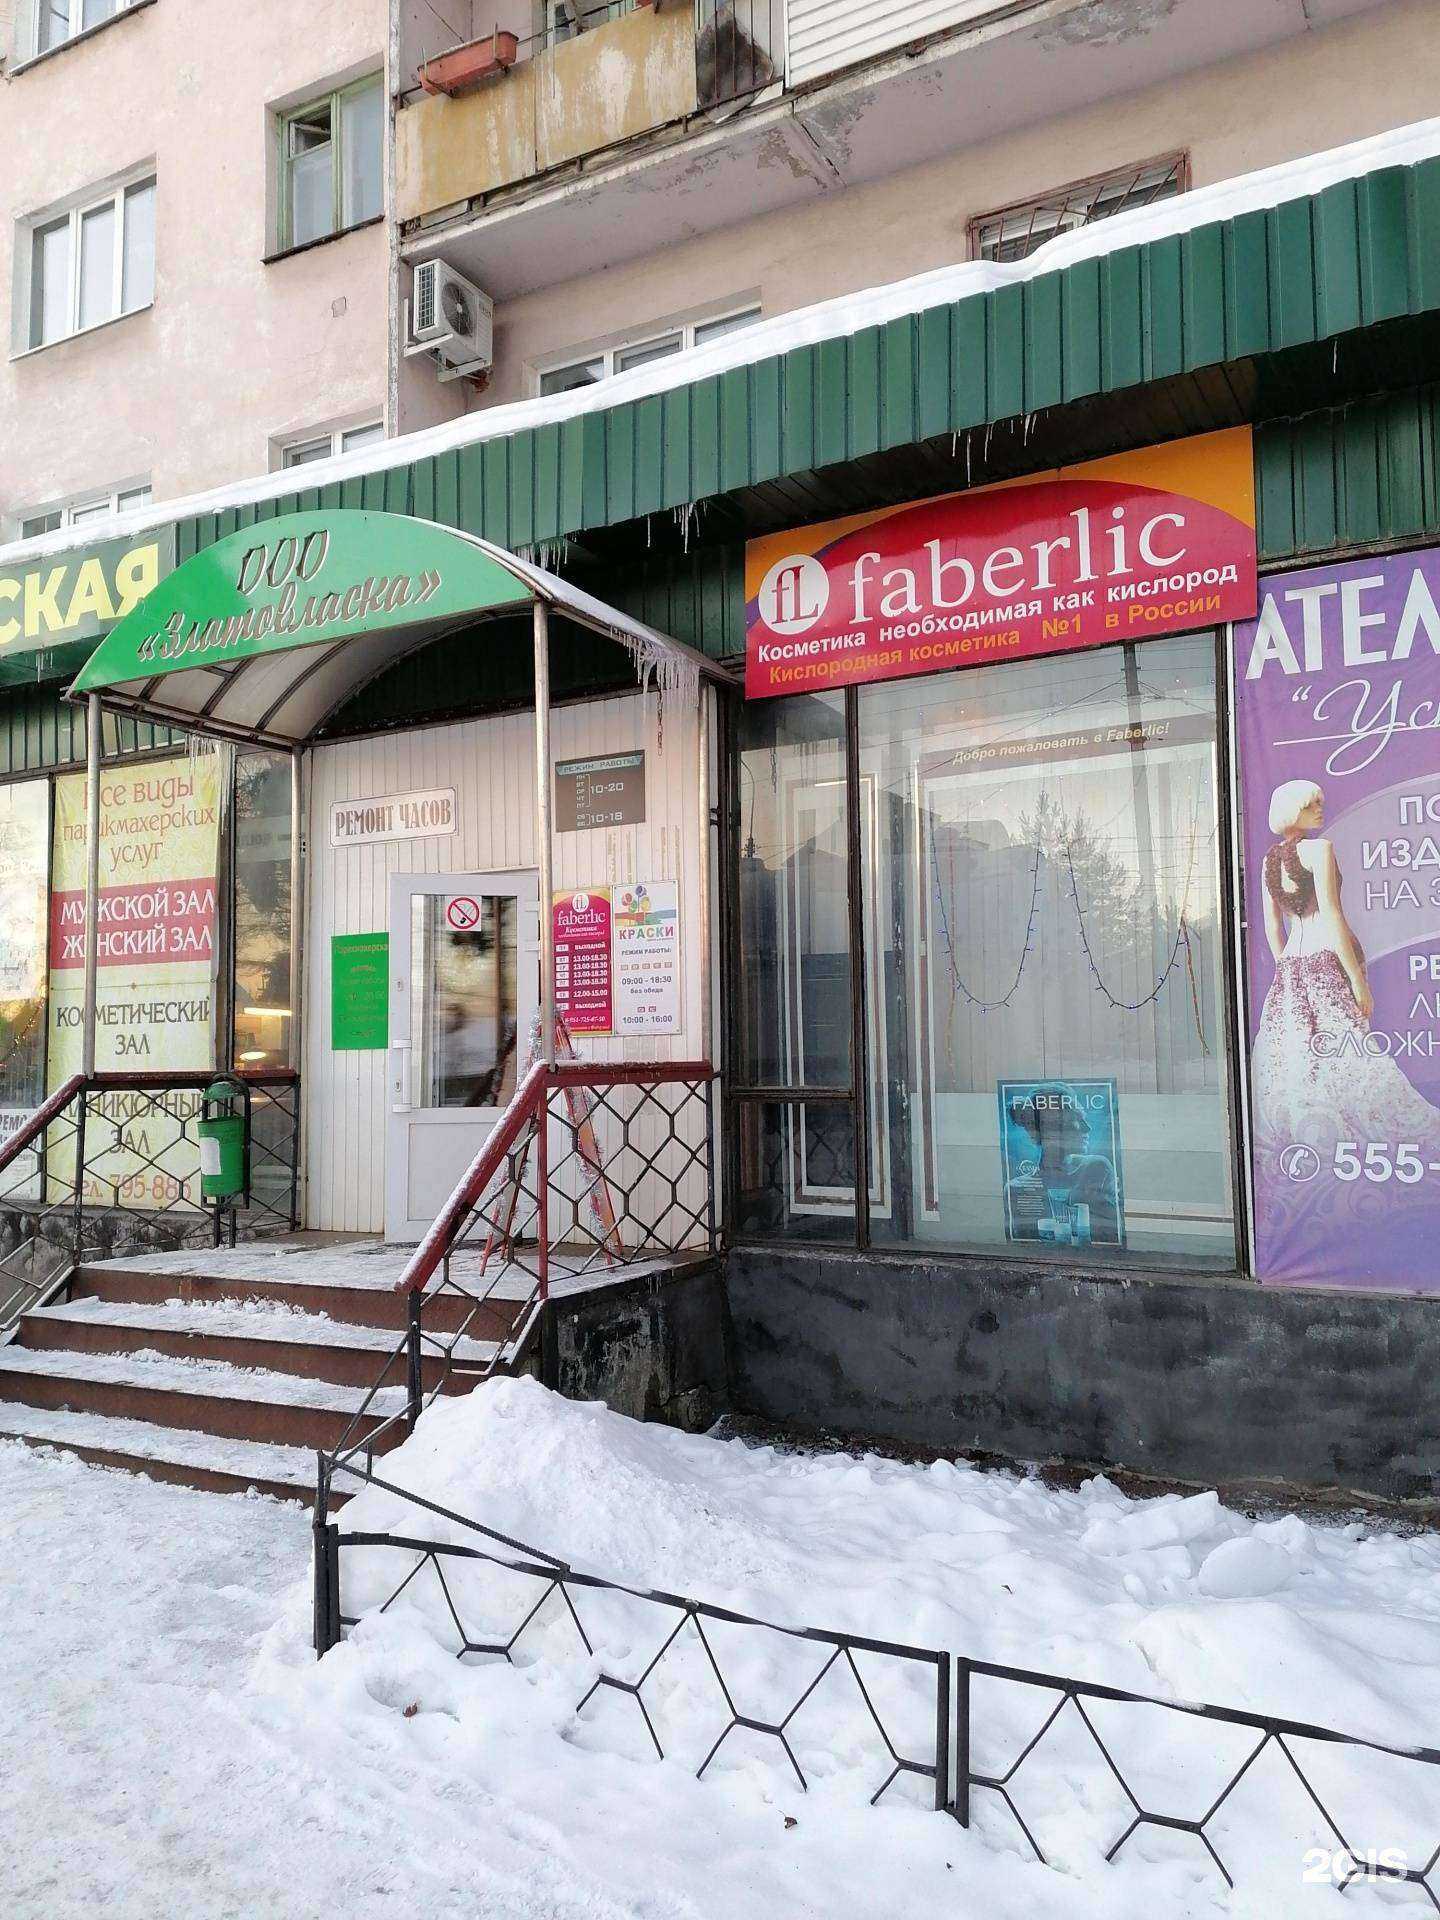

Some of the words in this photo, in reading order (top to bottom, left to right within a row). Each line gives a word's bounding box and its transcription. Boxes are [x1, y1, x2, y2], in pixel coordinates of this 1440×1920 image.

[237, 529, 330, 596] ООО
[849, 507, 1186, 625] faberlic
[136, 569, 442, 663] «Златовласка»
[758, 632, 866, 663] Косметика
[879, 600, 1043, 643] необходимая
[1053, 589, 1096, 612] как
[1107, 564, 1239, 602] кислород
[1246, 568, 1440, 680] АТЕЛ
[769, 650, 903, 684] Кислородная
[909, 630, 1020, 662] косметика
[1042, 614, 1081, 639] №1
[1105, 613, 1120, 629] в
[1128, 595, 1221, 624] России
[953, 748, 997, 765] Добро
[999, 736, 1089, 757] пожаловать
[1106, 722, 1170, 742] Faberlic!
[133, 775, 194, 808] виды
[590, 782, 624, 794] 10-20
[335, 804, 394, 837] РЕМОНТ
[399, 798, 451, 829] ЧАСОВ
[590, 811, 623, 823] 10-18
[110, 843, 164, 872] услуг
[173, 888, 215, 916] ЗАЛ
[1366, 880, 1421, 910] НА
[558, 909, 607, 926] faberlic
[170, 925, 213, 951] ЗАЛ
[619, 926, 674, 940] КРАСКИ
[621, 976, 643, 985] 09:00
[650, 975, 672, 984] 18:30
[622, 1016, 644, 1024] 10:00
[651, 1014, 673, 1023] 16:00
[115, 1034, 151, 1056] ЗАЛ
[63, 1093, 201, 1118] НИКЮРНЫ
[1012, 1094, 1105, 1111] FABERLIC
